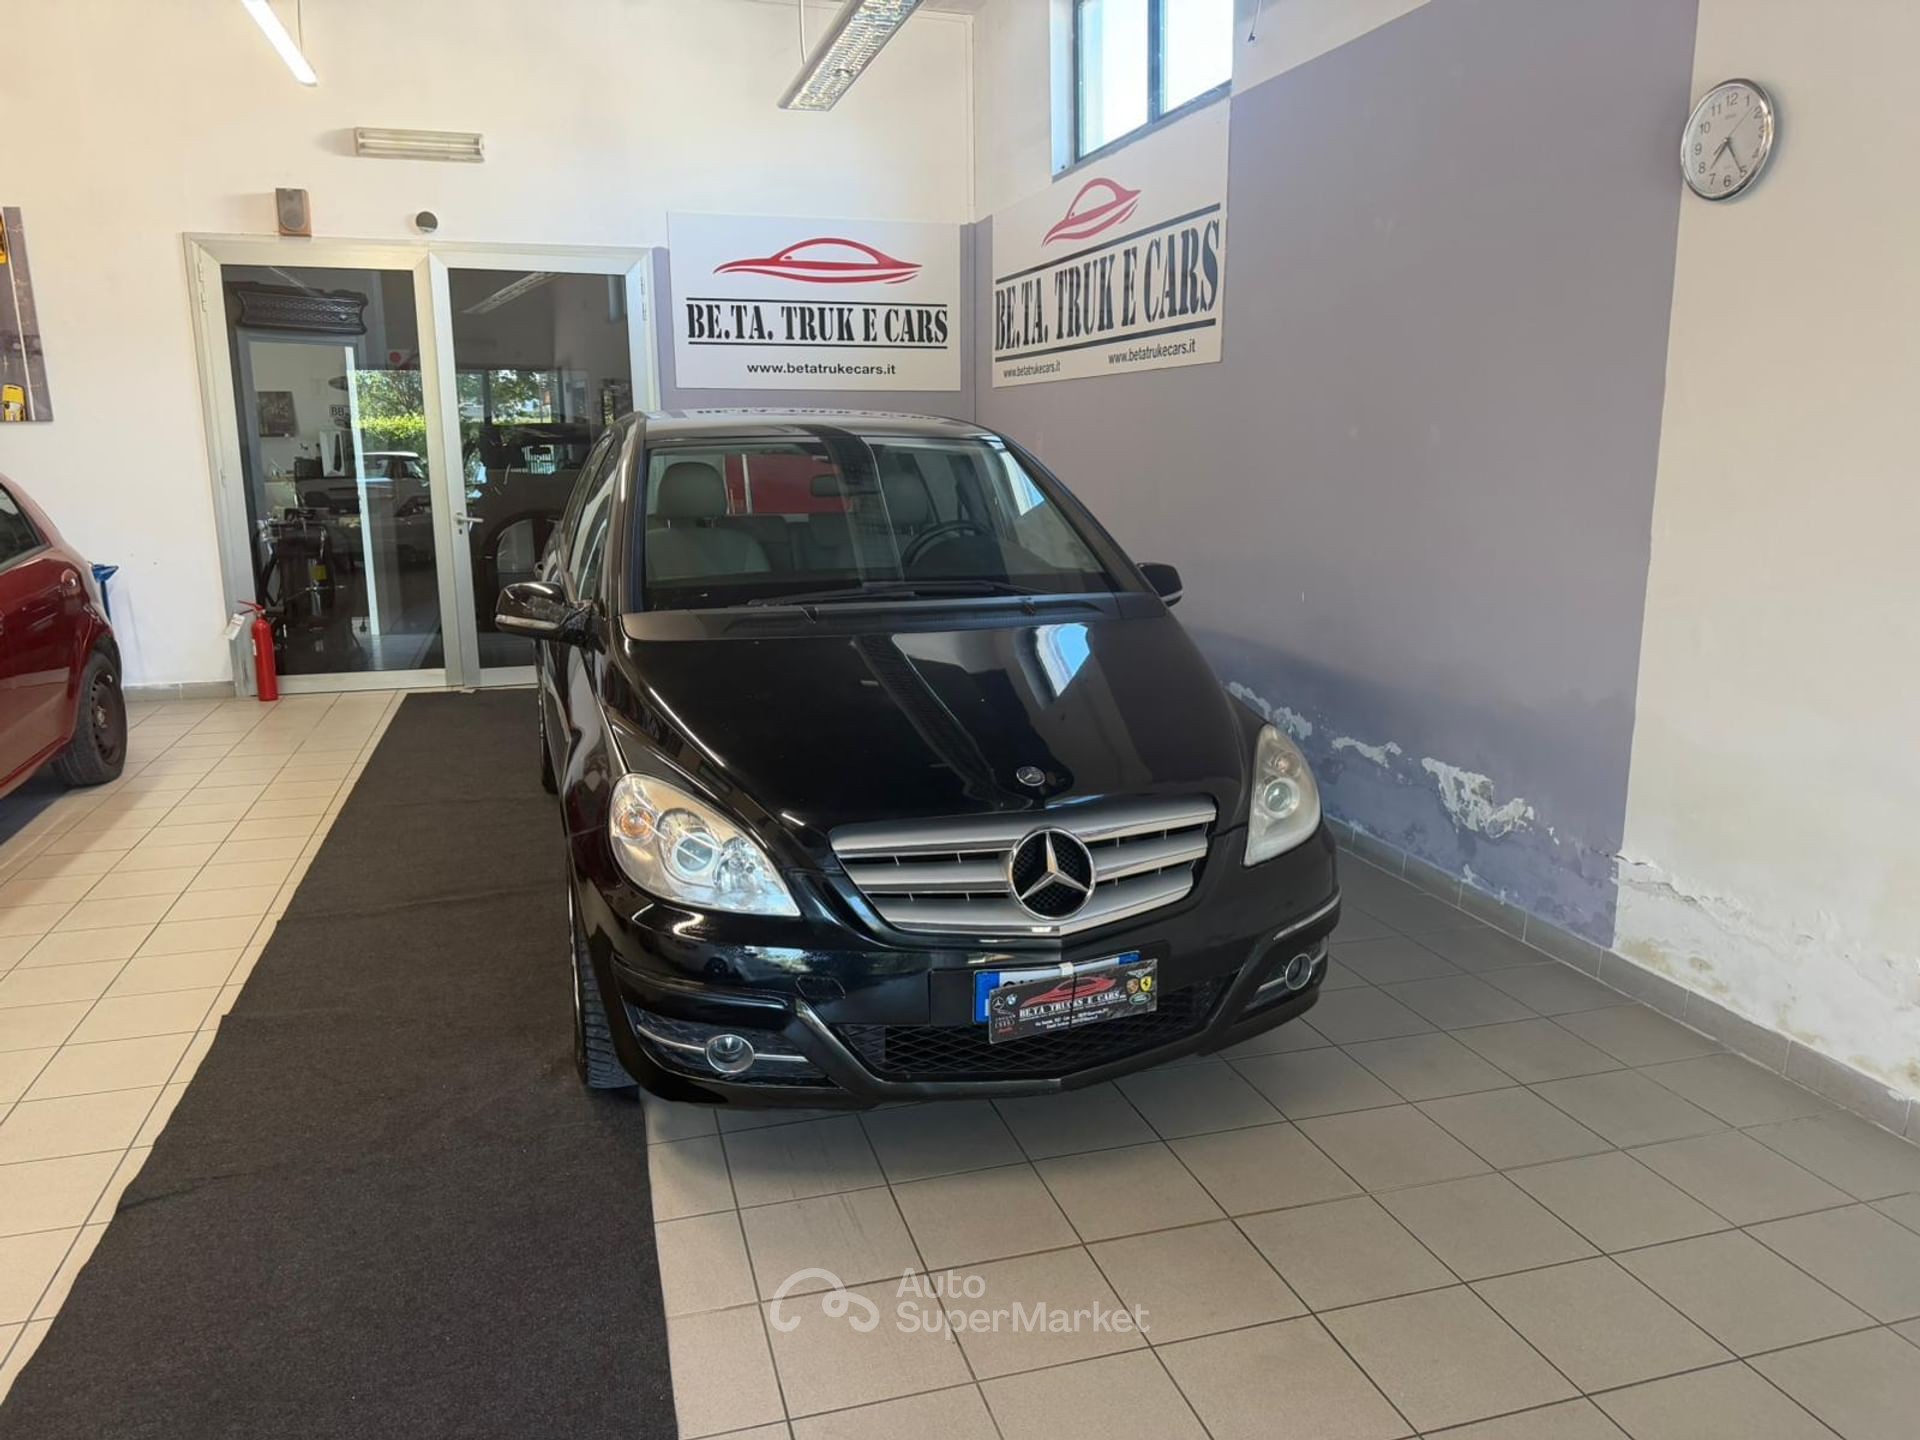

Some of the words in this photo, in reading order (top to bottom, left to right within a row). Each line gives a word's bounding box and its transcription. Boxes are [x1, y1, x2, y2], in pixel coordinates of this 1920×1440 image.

[1726, 92, 1738, 106] 12
[1745, 96, 1750, 106] 1
[1712, 104, 1722, 116] 11
[1754, 106, 1762, 119] 2
[1700, 121, 1710, 135] 10
[1695, 144, 1702, 156] 9
[1698, 162, 1706, 174] 8
[1739, 166, 1748, 178] 5
[1709, 173, 1716, 185] 7
[1723, 175, 1731, 187] 6
[995, 277, 1048, 351] BE.TA.
[1054, 254, 1115, 340] TRUK
[1121, 246, 1138, 327] E
[1144, 218, 1220, 323] CARS
[686, 303, 774, 341] BE.TA.
[781, 305, 855, 342] TRUK
[863, 308, 878, 342] E
[884, 309, 948, 344] CARS
[1107, 339, 1196, 365] www.betatrukecars.it
[747, 362, 896, 376] www.betatrukecars.it
